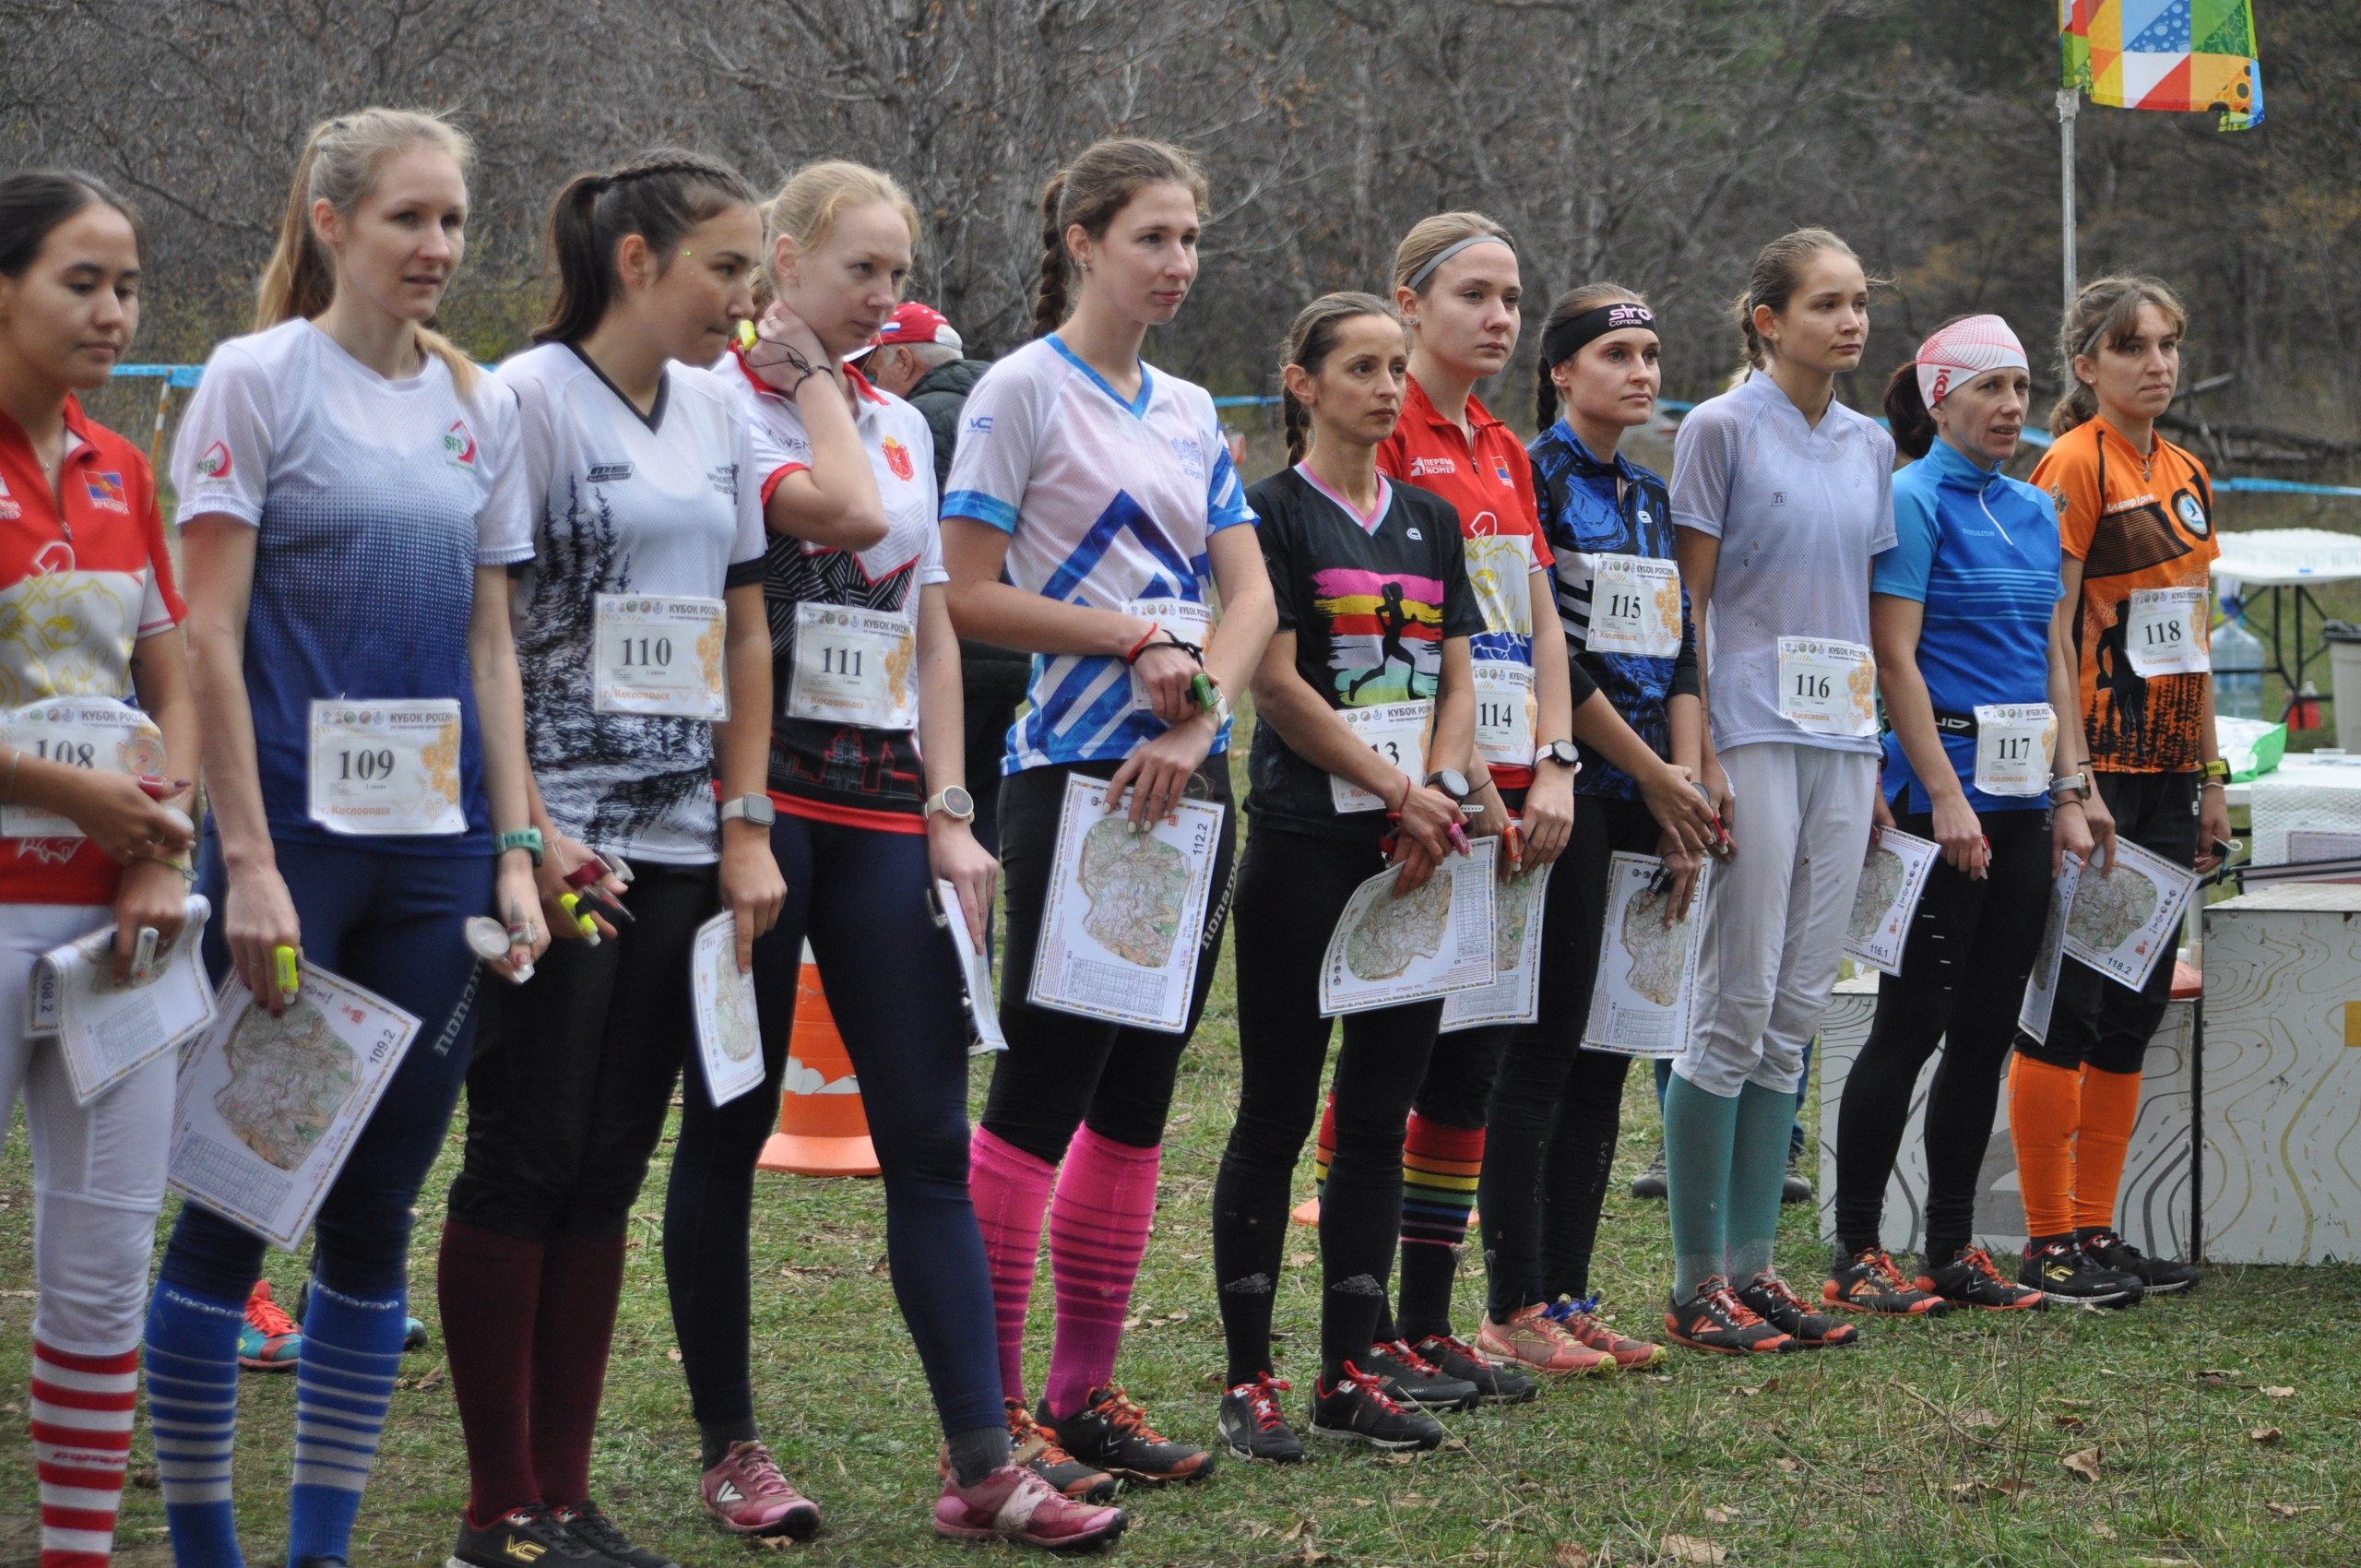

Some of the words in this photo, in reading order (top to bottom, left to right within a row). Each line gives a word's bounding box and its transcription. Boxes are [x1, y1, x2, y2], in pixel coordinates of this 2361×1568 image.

[445, 434, 465, 455] SFR
[196, 459, 217, 474] SFR
[669, 604, 698, 614] КУБОК
[1610, 594, 1642, 619] 115
[864, 618, 890, 631] КУБОК
[2144, 620, 2182, 645] 118
[622, 637, 672, 667] 110
[823, 647, 862, 677] 111
[1828, 647, 1848, 656] КУБОК
[614, 689, 670, 700] Кисловодск
[1796, 673, 1831, 699] 116
[811, 695, 864, 709] Кисловодск
[1388, 707, 1417, 718] КУБОК
[81, 709, 116, 722] КУБОК
[390, 713, 422, 723] КУБОК
[1479, 703, 1513, 728] 114
[36, 739, 96, 768] 108
[1998, 737, 2031, 760] 117
[338, 748, 396, 780] 109
[331, 805, 391, 817] Кисловодск
[1192, 823, 1209, 856] 112.2
[1870, 944, 1889, 958] 116.1
[2107, 957, 2132, 976] 118.2
[42, 973, 53, 1013] 108.2
[369, 1028, 397, 1064] 109.2
